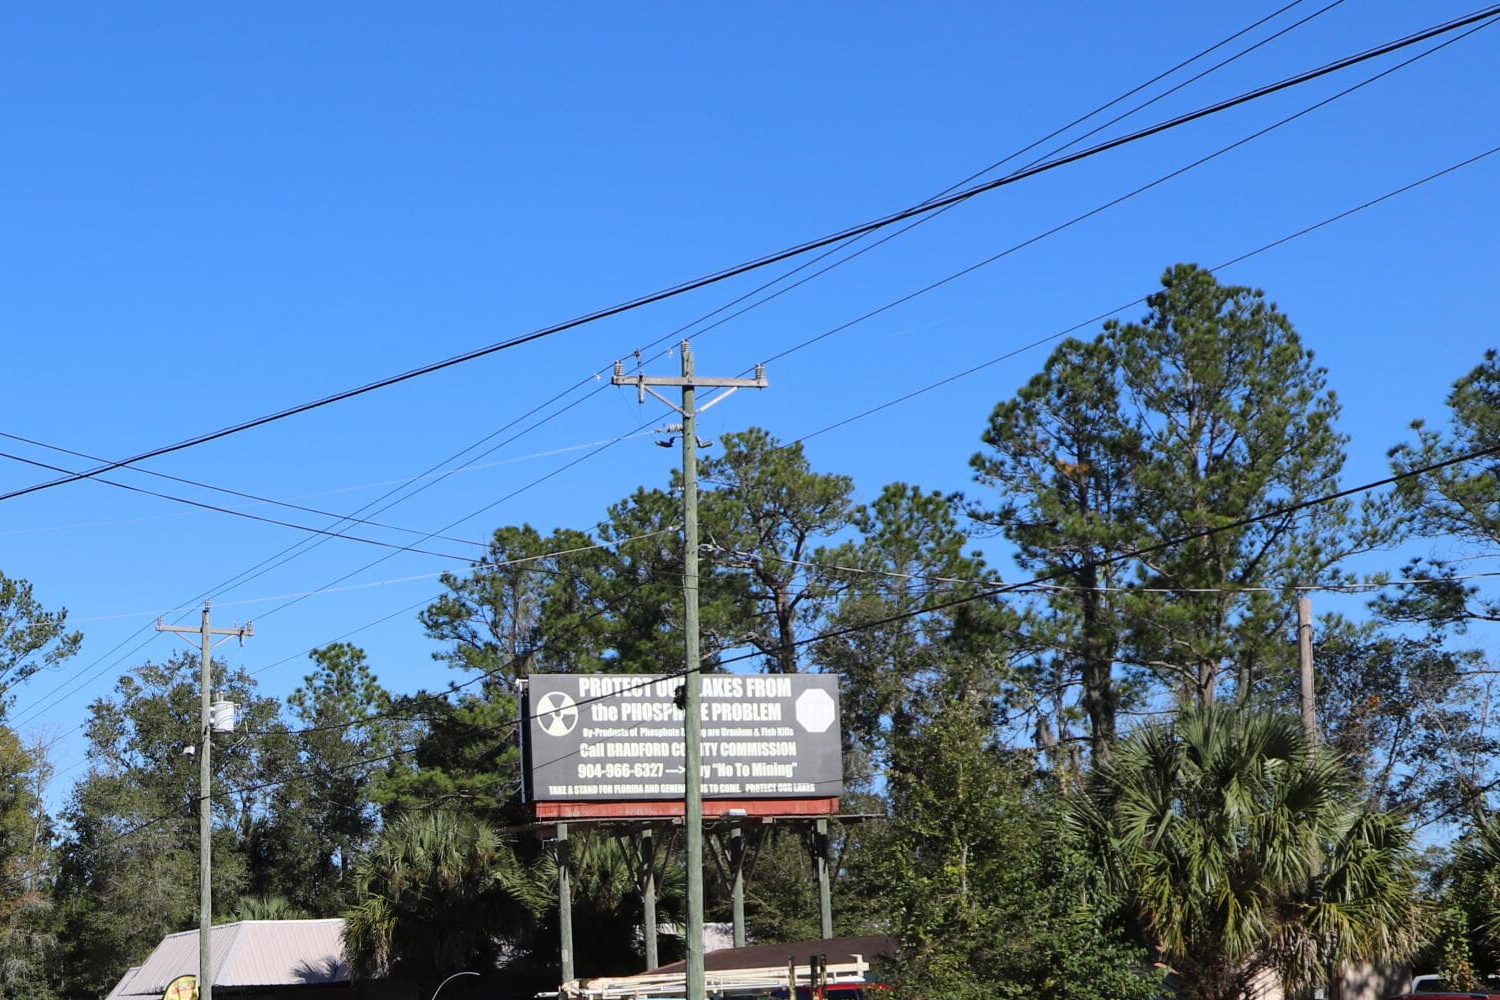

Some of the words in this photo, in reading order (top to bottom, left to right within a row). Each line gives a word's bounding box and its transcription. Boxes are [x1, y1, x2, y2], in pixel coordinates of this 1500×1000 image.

[579, 677, 652, 697] PROTECT
[700, 677, 743, 697] AKES
[746, 677, 792, 697] FROM
[592, 704, 618, 721] the
[712, 702, 782, 721] PROBLEM
[583, 728, 629, 738] By-Products
[630, 728, 638, 737] of
[640, 727, 680, 737] Phosphate
[721, 727, 753, 736] Uranium
[754, 727, 760, 736] &
[761, 727, 776, 736] Fish
[777, 727, 794, 736] Kills
[580, 743, 605, 757] Call
[607, 743, 670, 757] BRADFORD
[720, 742, 797, 757] COMMISSION
[578, 763, 664, 779] 904-966-6327
[734, 763, 750, 777] To
[752, 762, 798, 778] Mining"
[549, 786, 567, 795] TAKE
[568, 786, 574, 795] A
[574, 785, 598, 795] STAND
[599, 785, 613, 794] FOR
[614, 785, 644, 794] FLORIDA
[645, 785, 660, 794] AND
[709, 784, 719, 792] TO
[720, 783, 742, 793] COME.
[746, 783, 777, 792] PROTECT
[778, 783, 793, 792] OUR
